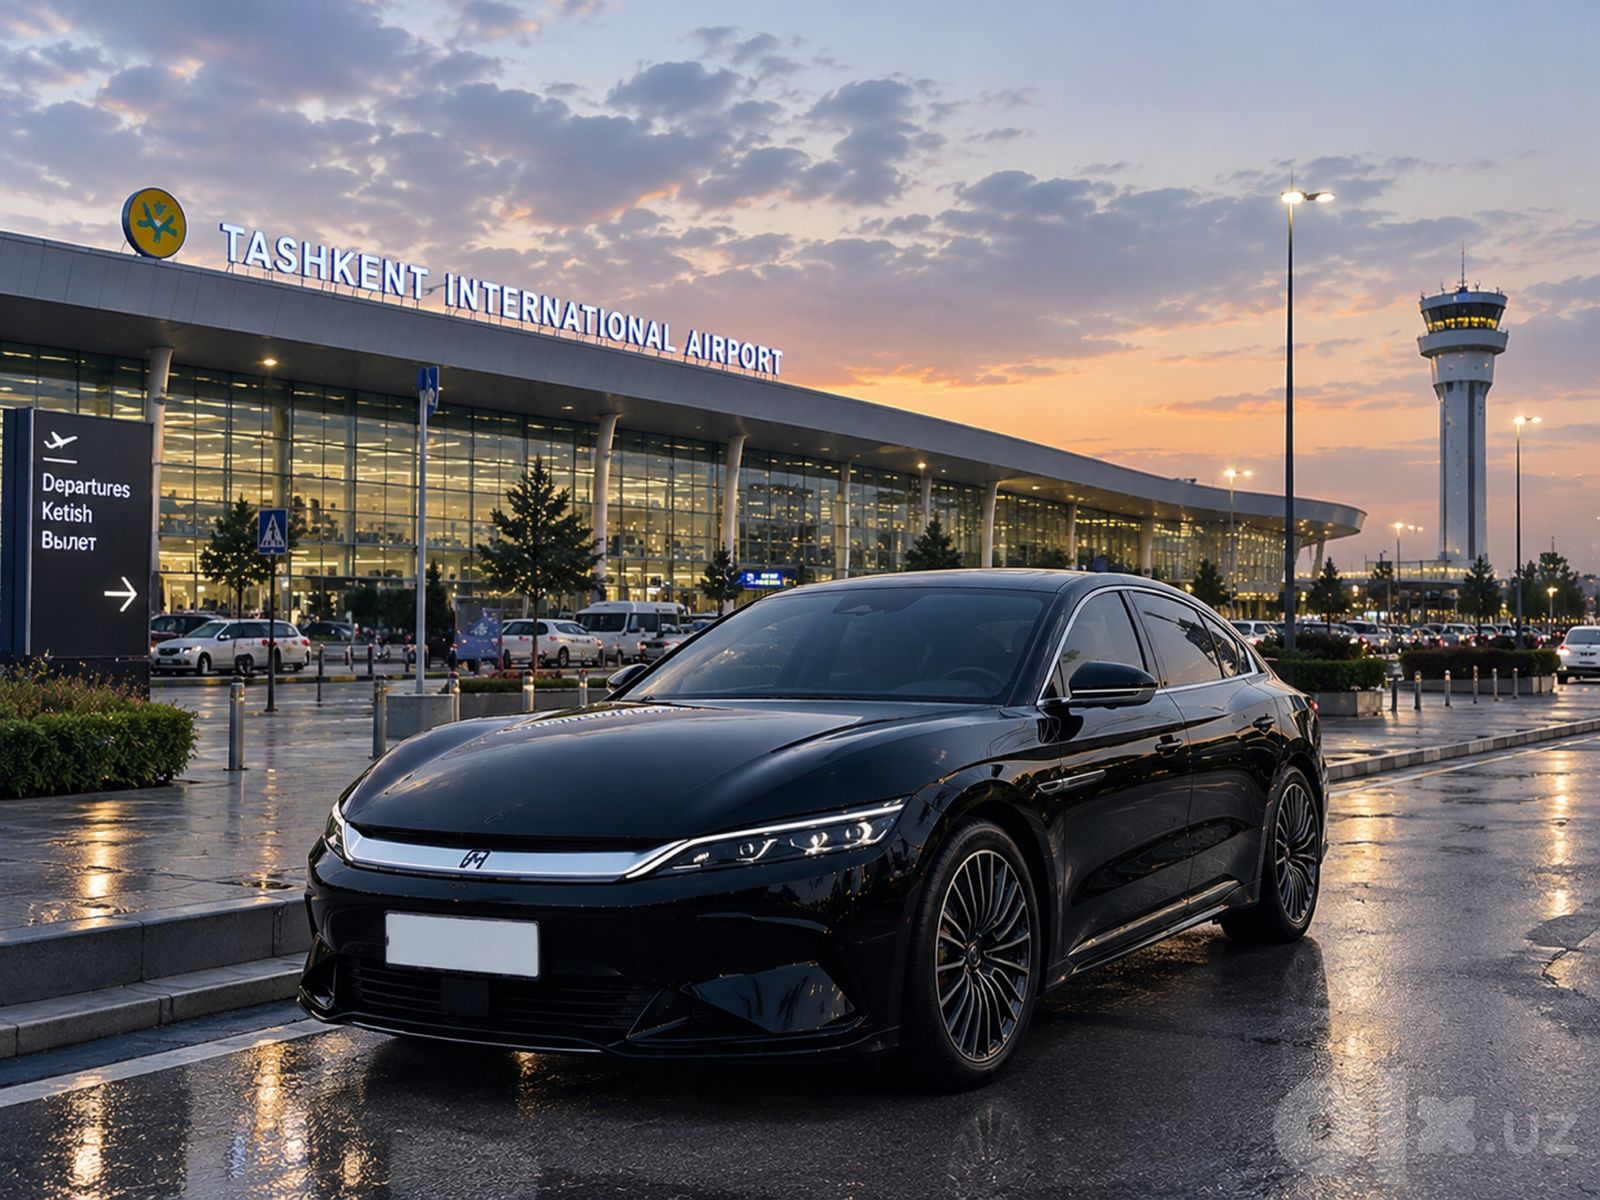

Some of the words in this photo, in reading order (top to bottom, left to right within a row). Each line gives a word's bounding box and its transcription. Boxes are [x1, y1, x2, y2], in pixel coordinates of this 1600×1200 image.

[220, 223, 428, 300] TASHKENT
[444, 273, 676, 353] INTERNATIONAL
[684, 330, 783, 375] AIRPORT
[42, 472, 131, 498] Departures
[42, 502, 93, 523] Ketish
[41, 531, 97, 551] Вылет
